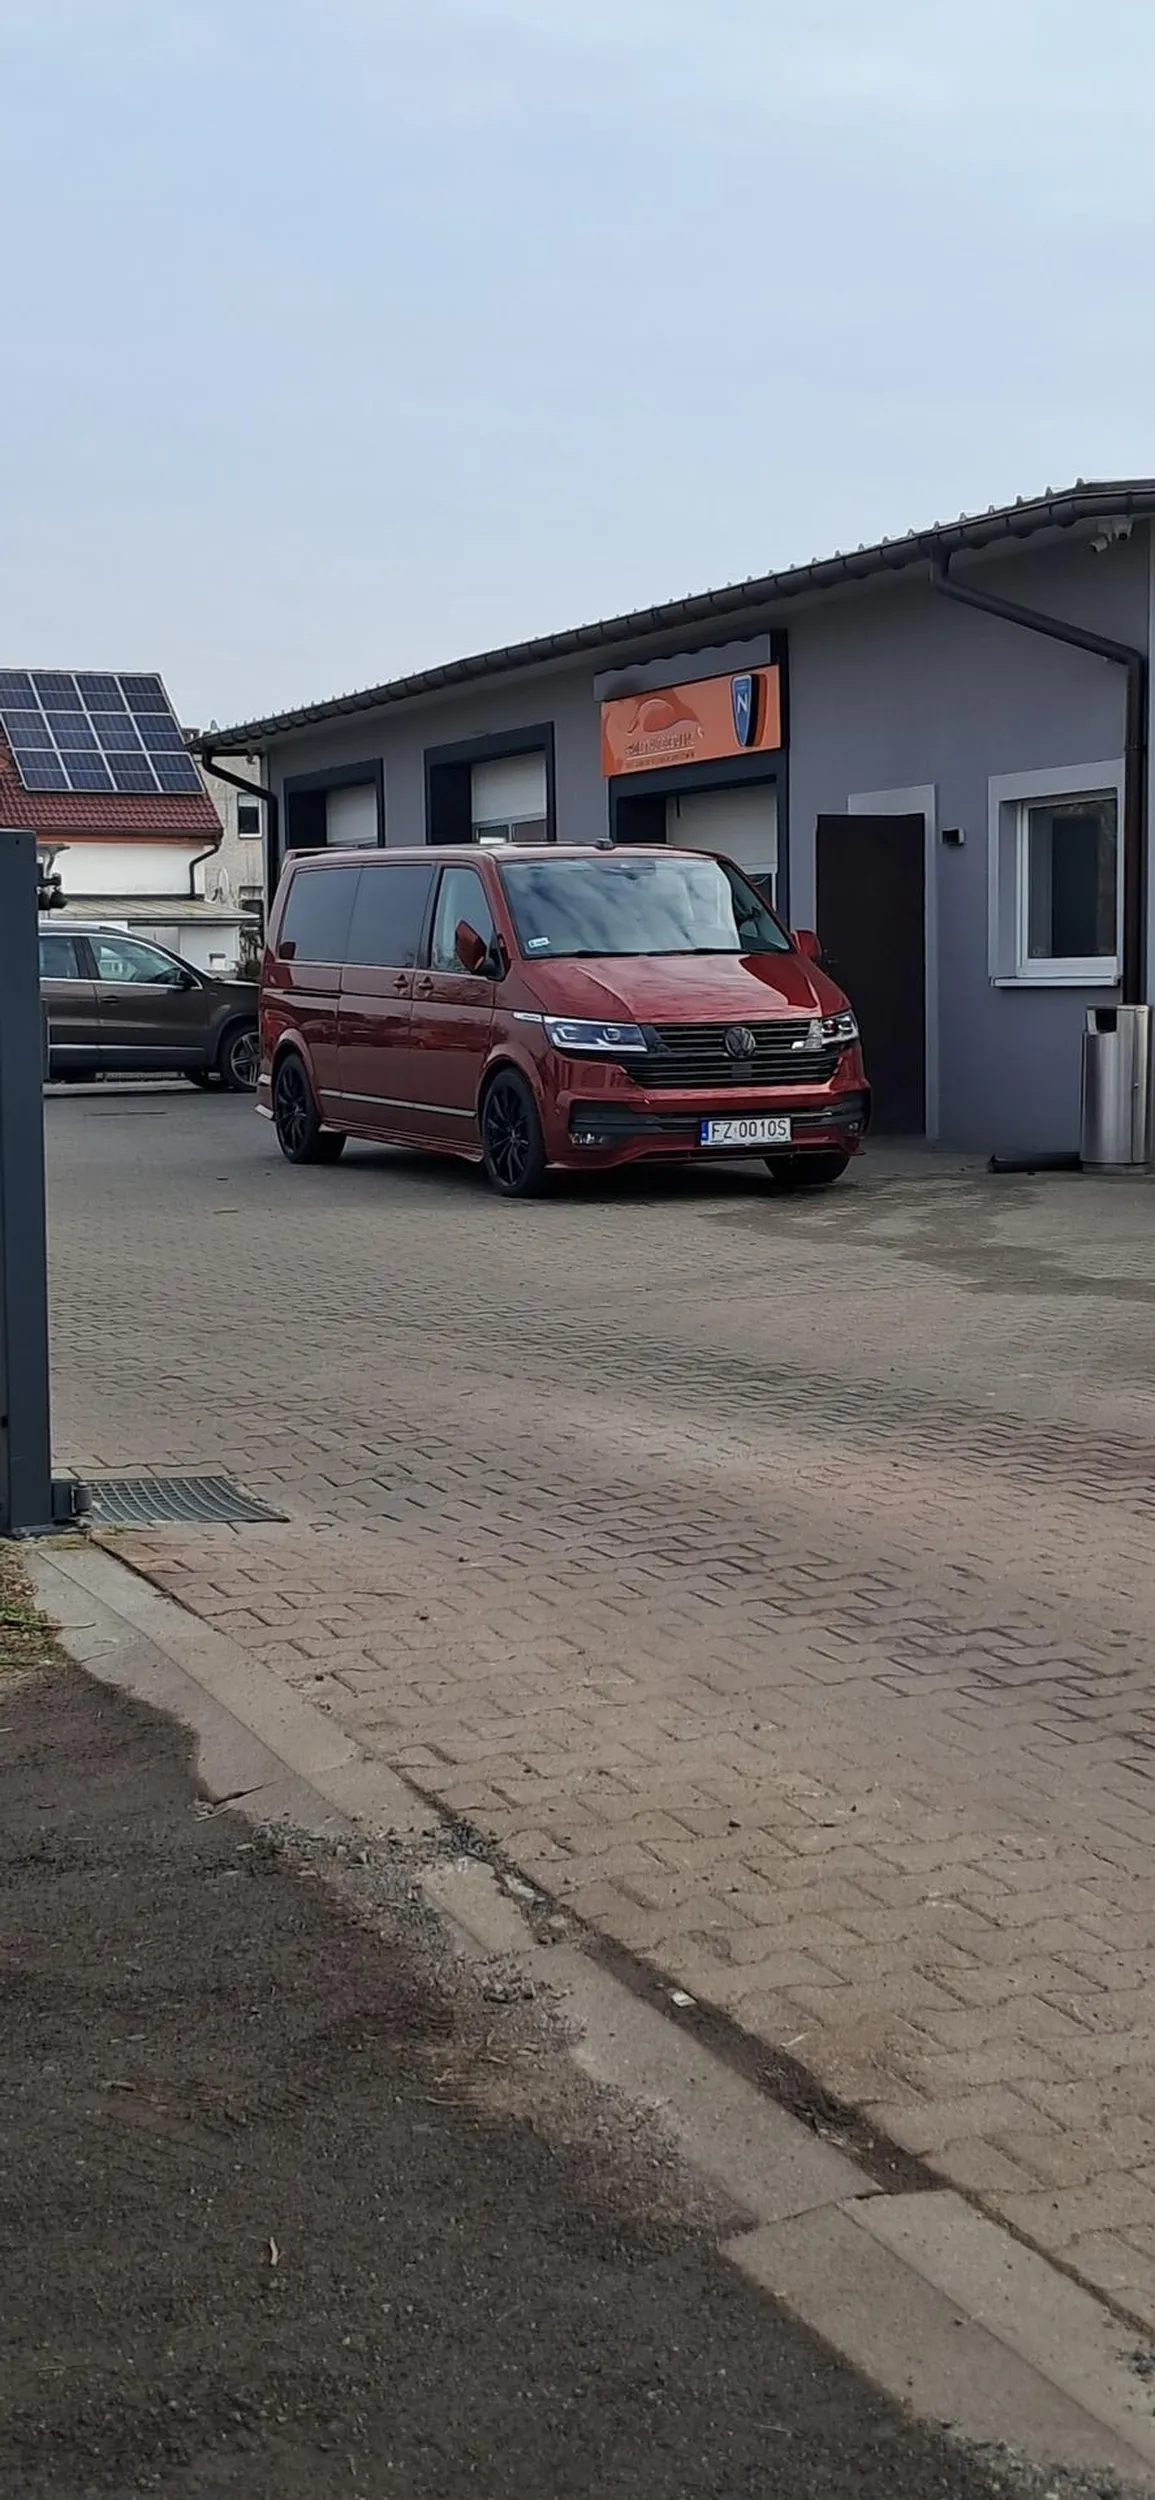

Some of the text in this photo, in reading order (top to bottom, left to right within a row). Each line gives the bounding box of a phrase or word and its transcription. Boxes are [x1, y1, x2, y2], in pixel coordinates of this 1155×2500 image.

[737, 692, 748, 714] N
[711, 1121, 732, 1139] FZ
[739, 1120, 787, 1138] 0010S
